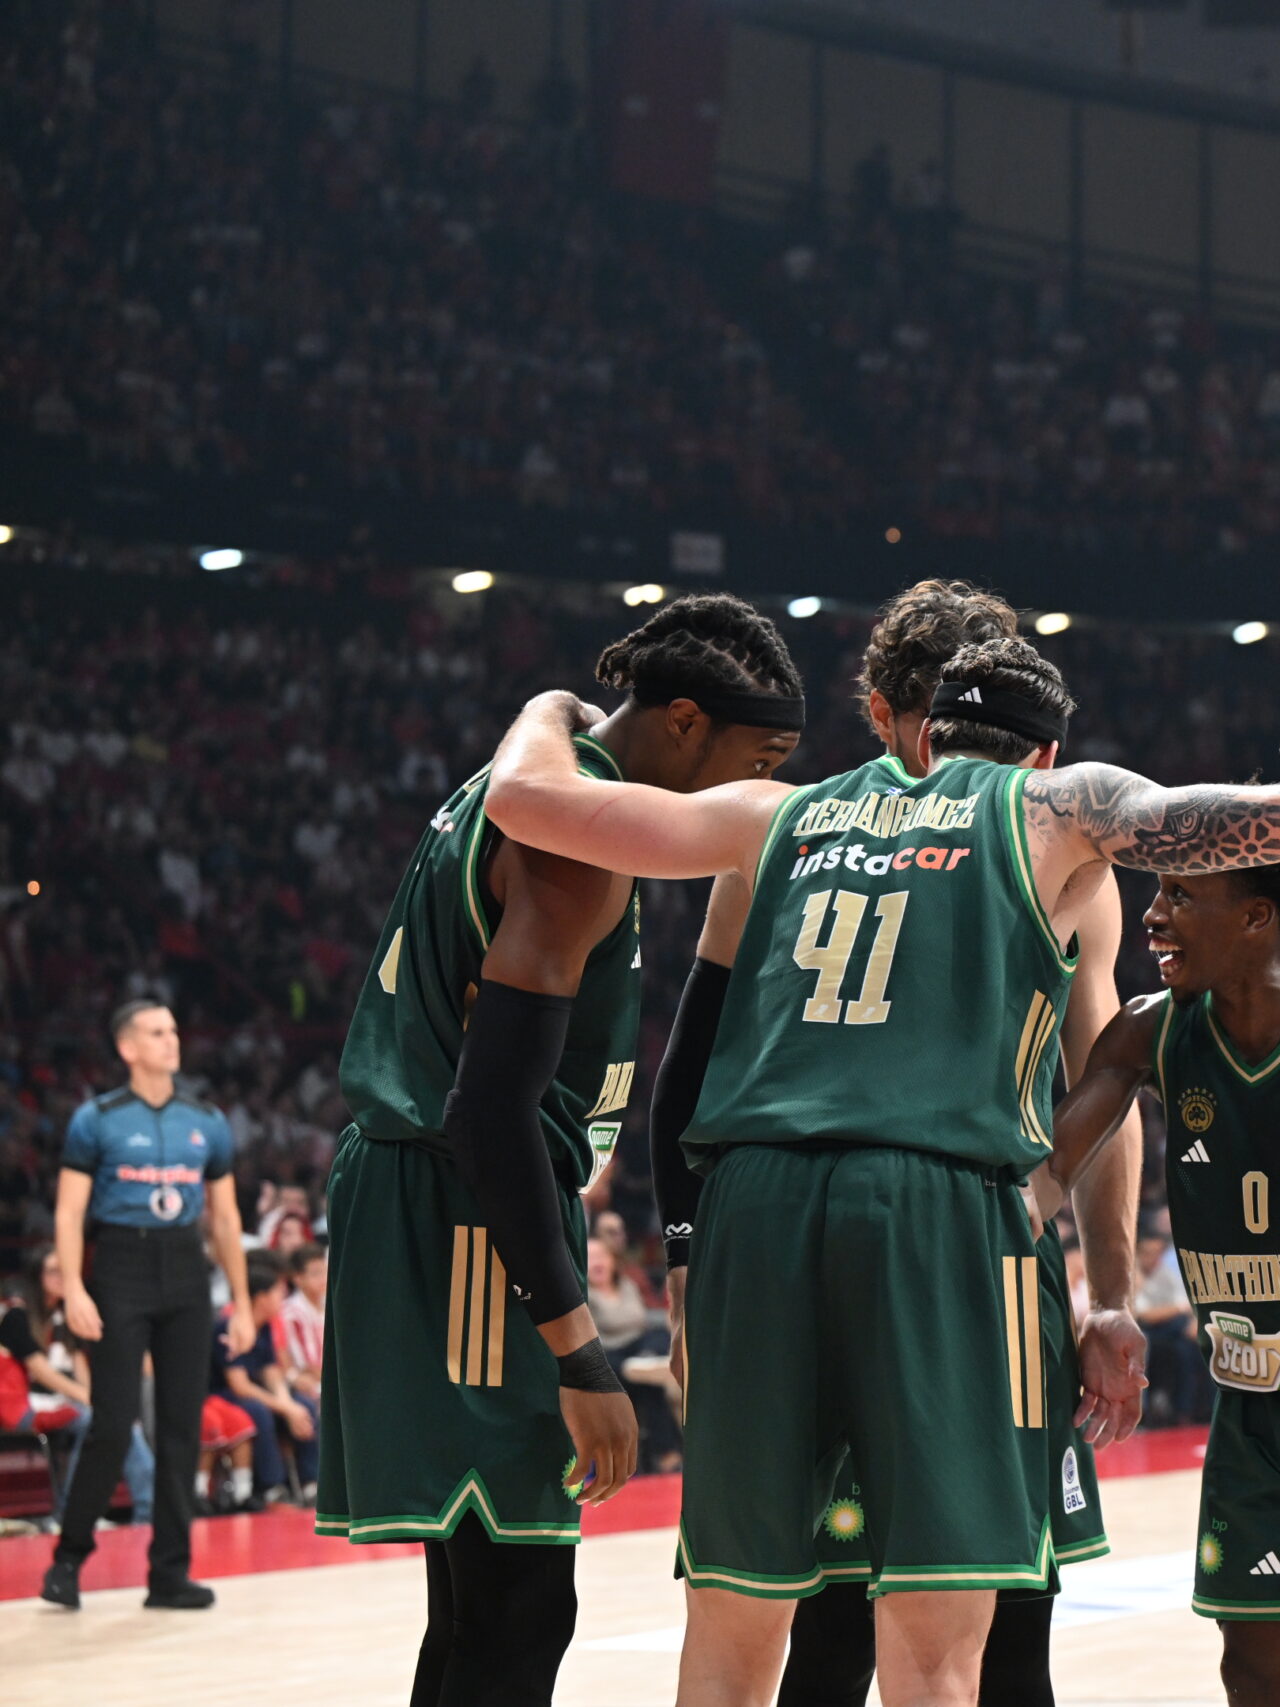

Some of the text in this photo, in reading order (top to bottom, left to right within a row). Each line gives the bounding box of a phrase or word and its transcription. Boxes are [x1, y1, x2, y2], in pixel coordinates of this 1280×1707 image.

[789, 844, 971, 880] instacar
[792, 889, 909, 1025] 41
[1242, 1170, 1269, 1234] 0
[1219, 1318, 1249, 1337] pame
[1066, 1493, 1083, 1510] GBL
[1211, 1517, 1228, 1533] bp
